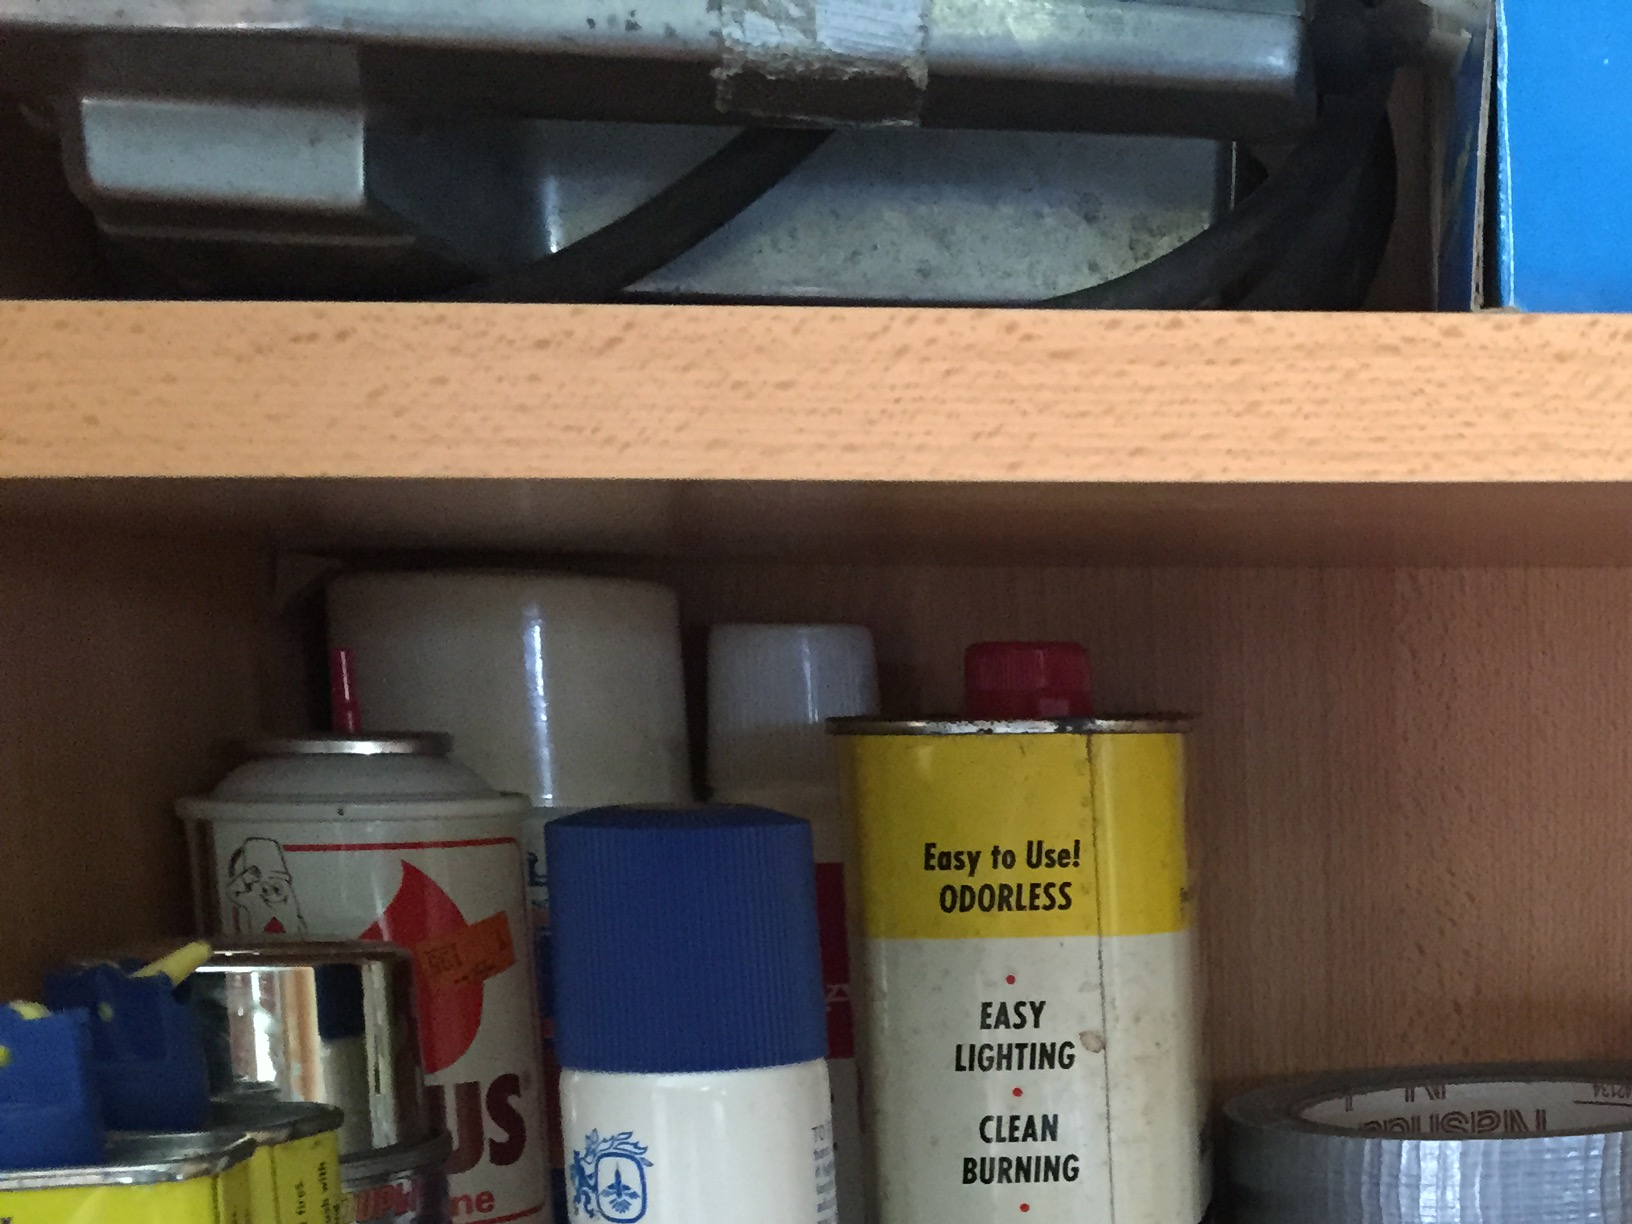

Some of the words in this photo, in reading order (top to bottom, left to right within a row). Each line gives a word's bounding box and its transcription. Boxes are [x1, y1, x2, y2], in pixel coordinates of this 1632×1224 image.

[924, 841, 981, 877] Easy
[991, 843, 1016, 870] to
[1026, 840, 1081, 869] Use!
[939, 881, 1073, 913] ODORLESS
[979, 1001, 1046, 1030] EASY
[955, 1041, 1076, 1072] LIGHTING
[979, 1113, 1059, 1143] CLEAN
[962, 1153, 1080, 1185] BURNING
